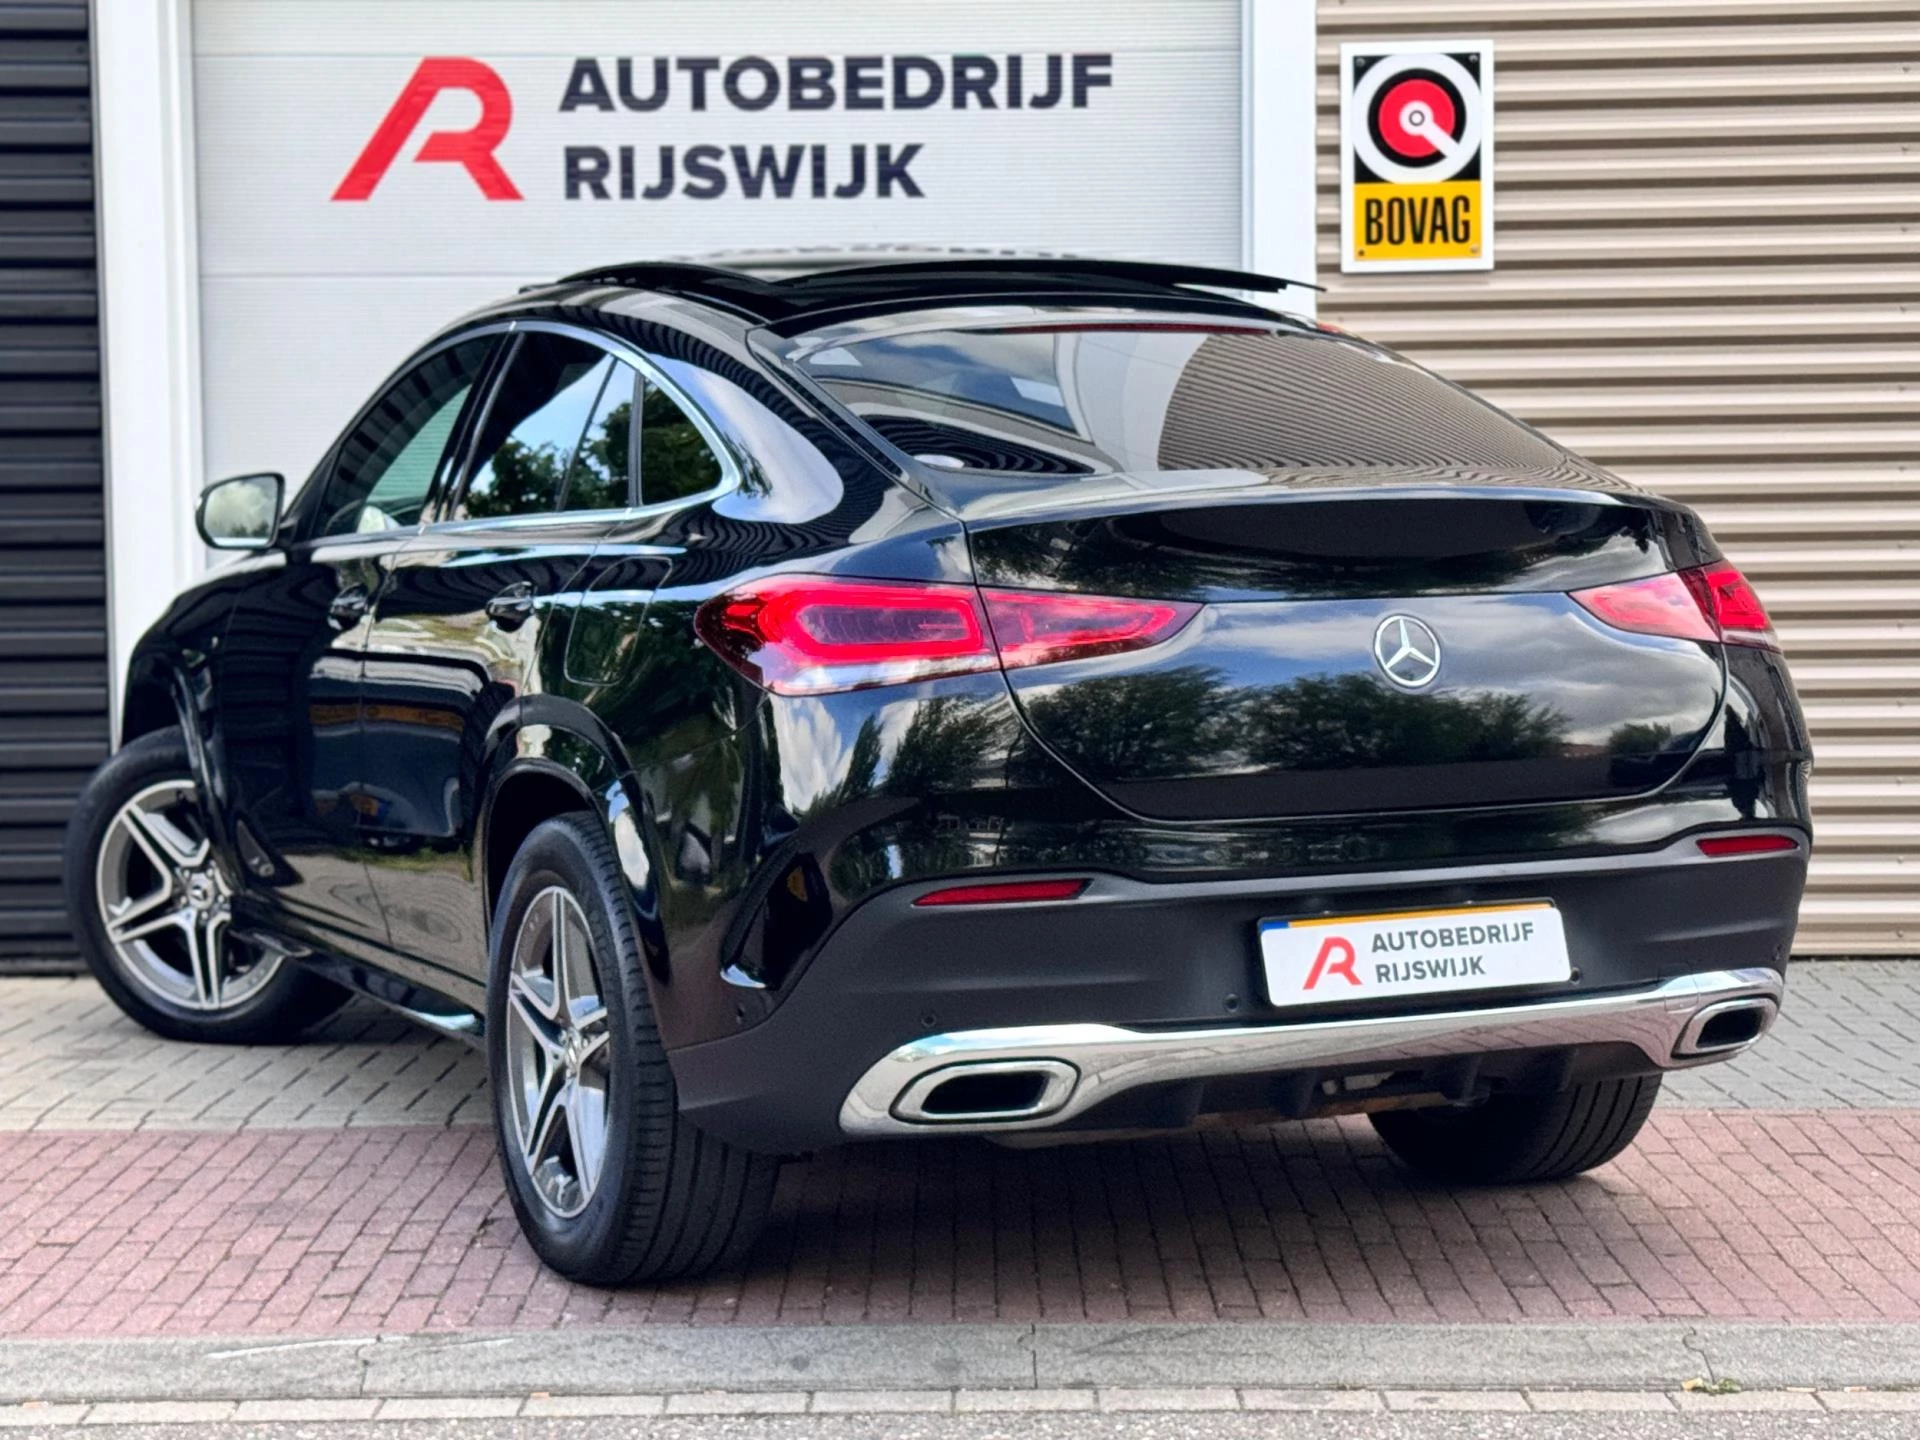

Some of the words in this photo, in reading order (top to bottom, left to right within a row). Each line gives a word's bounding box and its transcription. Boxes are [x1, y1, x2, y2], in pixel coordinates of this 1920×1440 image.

[558, 52, 1113, 113] AUTOBEDRIJF
[563, 143, 925, 201] RIJSWIJK
[1365, 195, 1471, 246] BOVAG
[1371, 921, 1535, 953] AUTOBEDRIJF
[1375, 955, 1487, 984] RIJSWIJK
